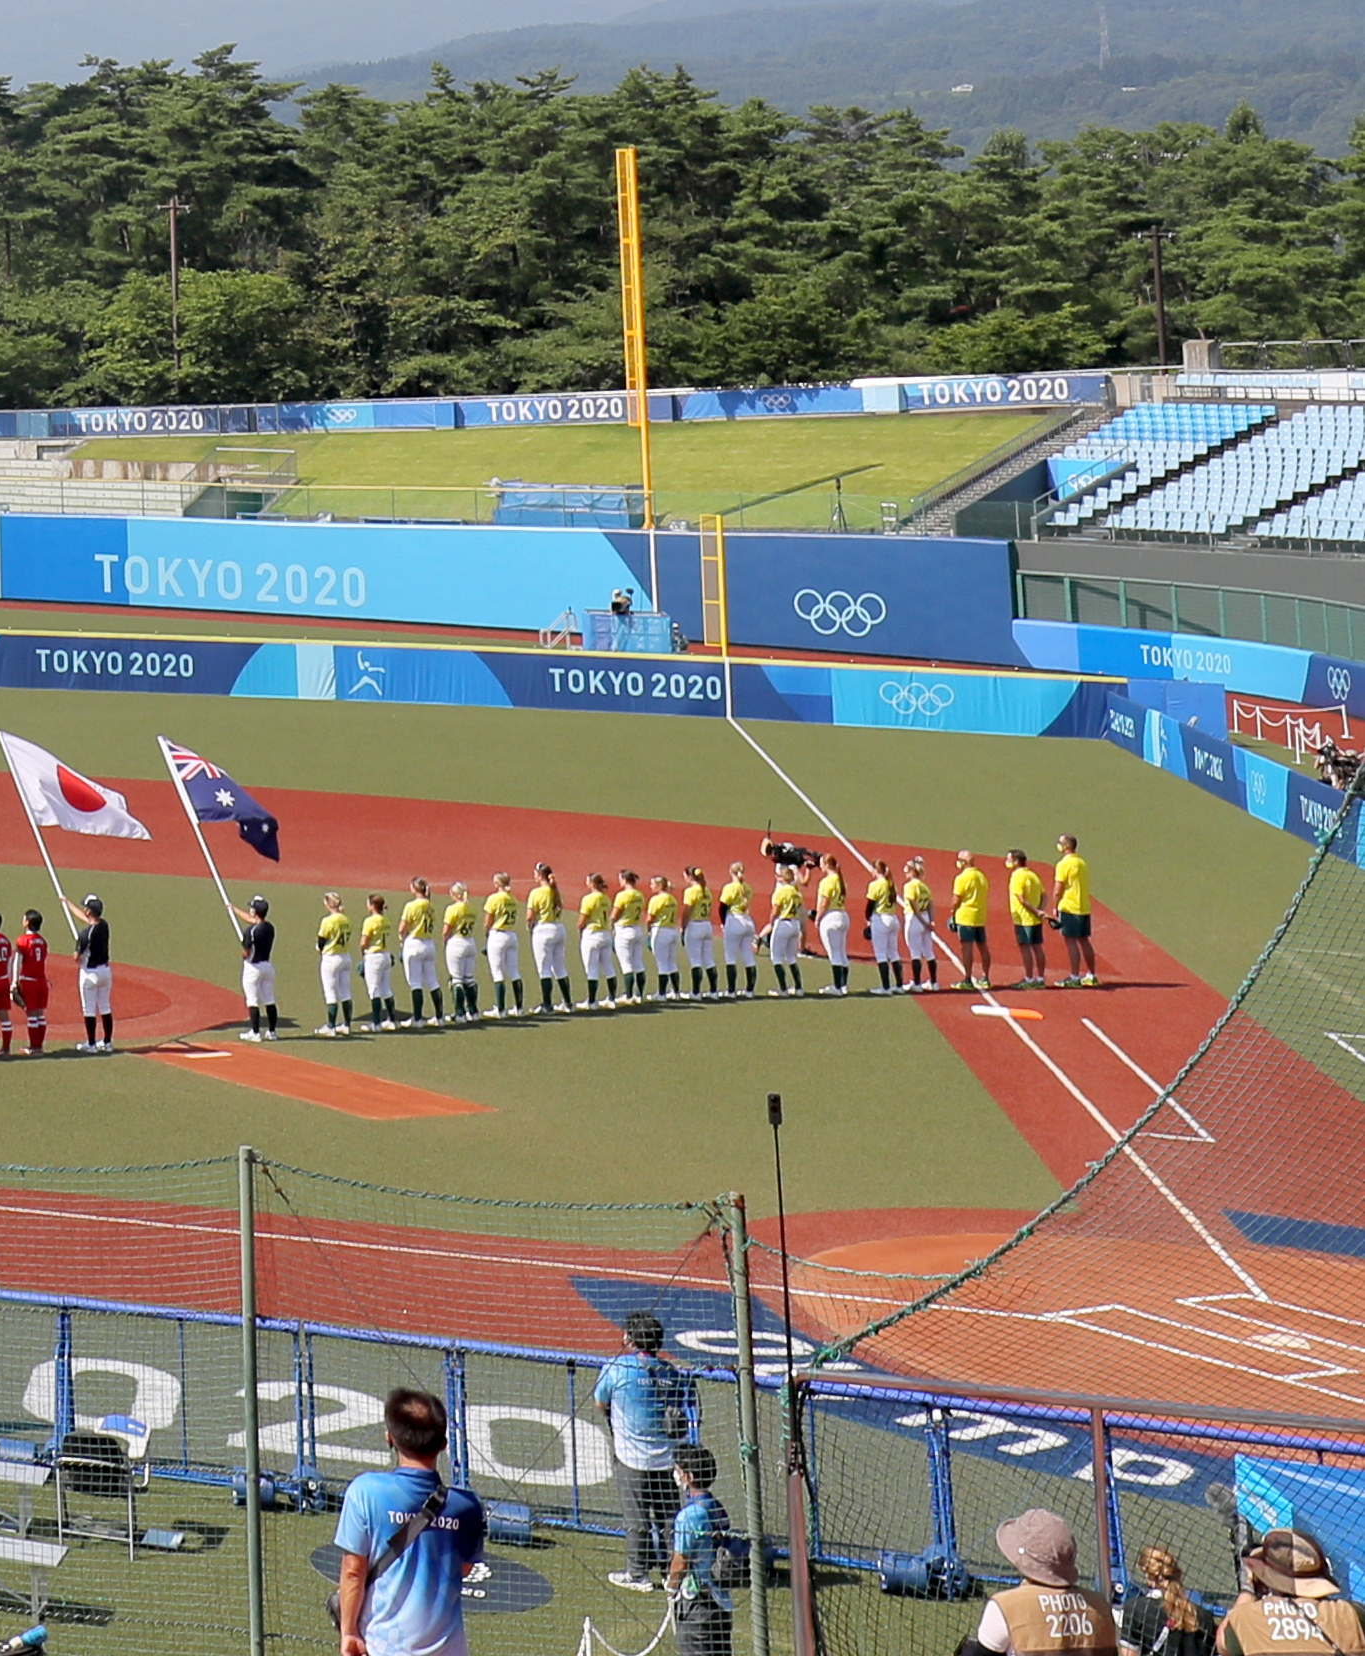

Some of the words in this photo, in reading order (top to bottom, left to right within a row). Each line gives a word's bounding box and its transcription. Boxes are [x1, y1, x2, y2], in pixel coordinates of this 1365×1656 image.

[917, 380, 1002, 406] TOKYO
[1007, 377, 1070, 402] 2020
[78, 411, 147, 434] TOKYO
[151, 410, 203, 430] 2020
[487, 399, 563, 422] TOKYO
[567, 398, 623, 419] 2020
[94, 554, 242, 600] TOKYO
[255, 562, 366, 608] 2020
[35, 648, 123, 674] TOKYO
[129, 652, 194, 678] 2020
[1139, 644, 1193, 670] TOKYO
[1195, 653, 1231, 674] 2020
[549, 668, 645, 697] TOKYO
[650, 672, 723, 700] 2020
[1038, 1593, 1087, 1612] PHOTO
[1046, 1612, 1093, 1638] 2206
